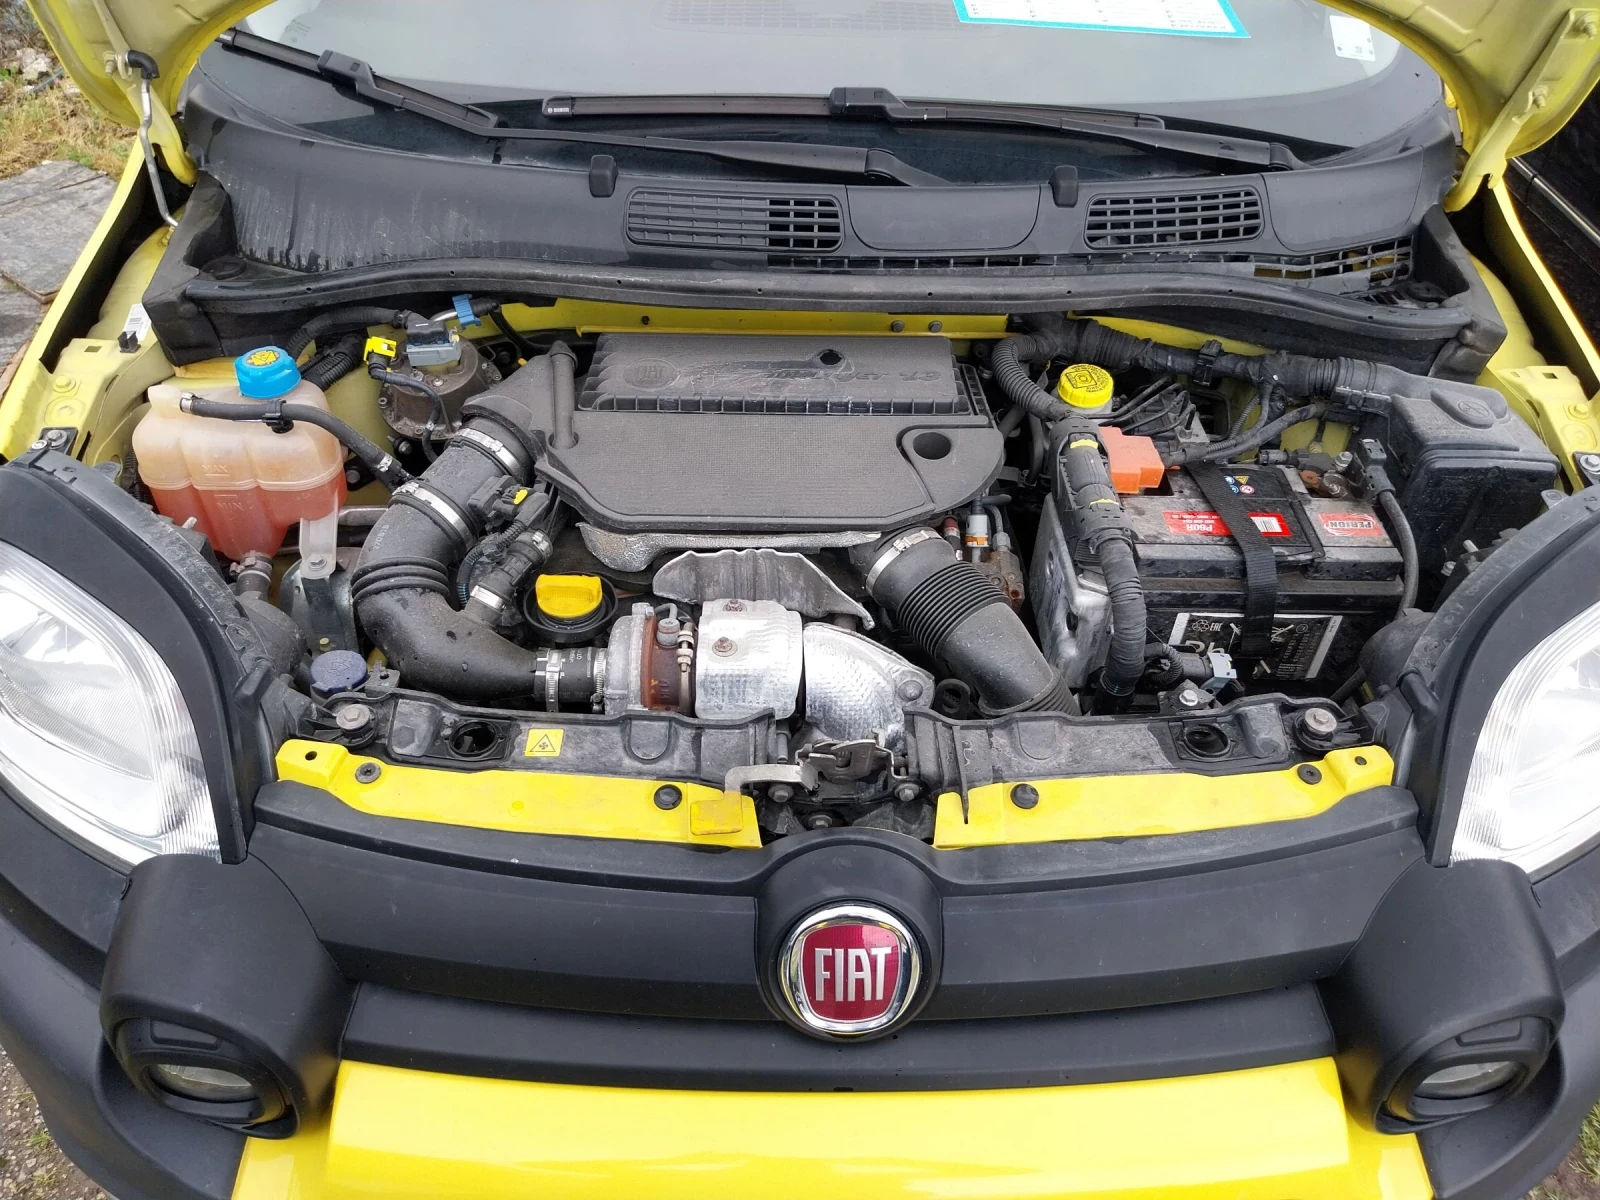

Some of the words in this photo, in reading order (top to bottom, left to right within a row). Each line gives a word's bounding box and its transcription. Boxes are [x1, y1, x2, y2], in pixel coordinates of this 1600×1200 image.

[201, 464, 228, 473] MAX
[216, 502, 244, 511] MIN
[1186, 524, 1213, 532] P60R
[815, 947, 892, 1001] FIAT
